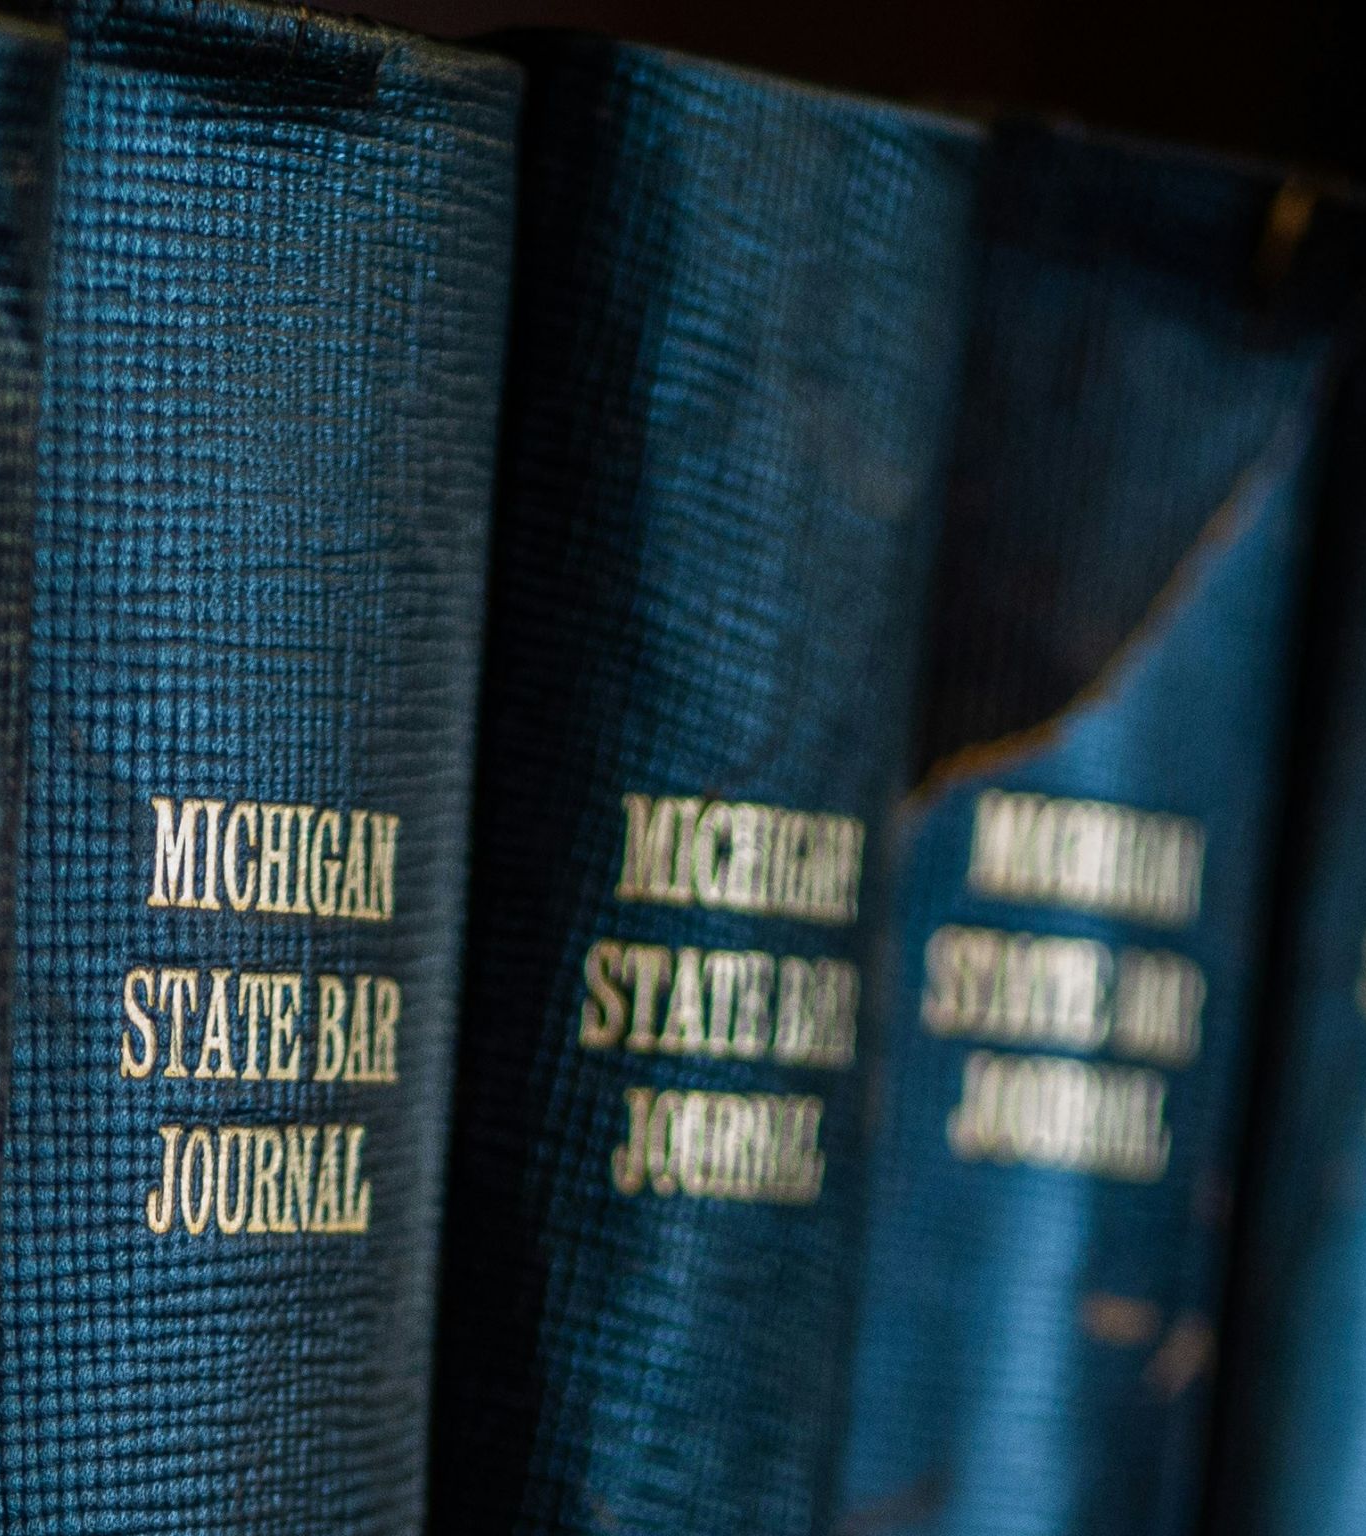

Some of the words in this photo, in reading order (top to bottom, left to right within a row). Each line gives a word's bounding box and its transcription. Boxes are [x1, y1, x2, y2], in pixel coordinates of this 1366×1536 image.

[147, 797, 400, 921] MICHIGAN
[120, 966, 302, 1081] STATE
[312, 974, 402, 1084] BAR
[579, 938, 775, 1058] STATE
[145, 1123, 371, 1235] JOURNAL
